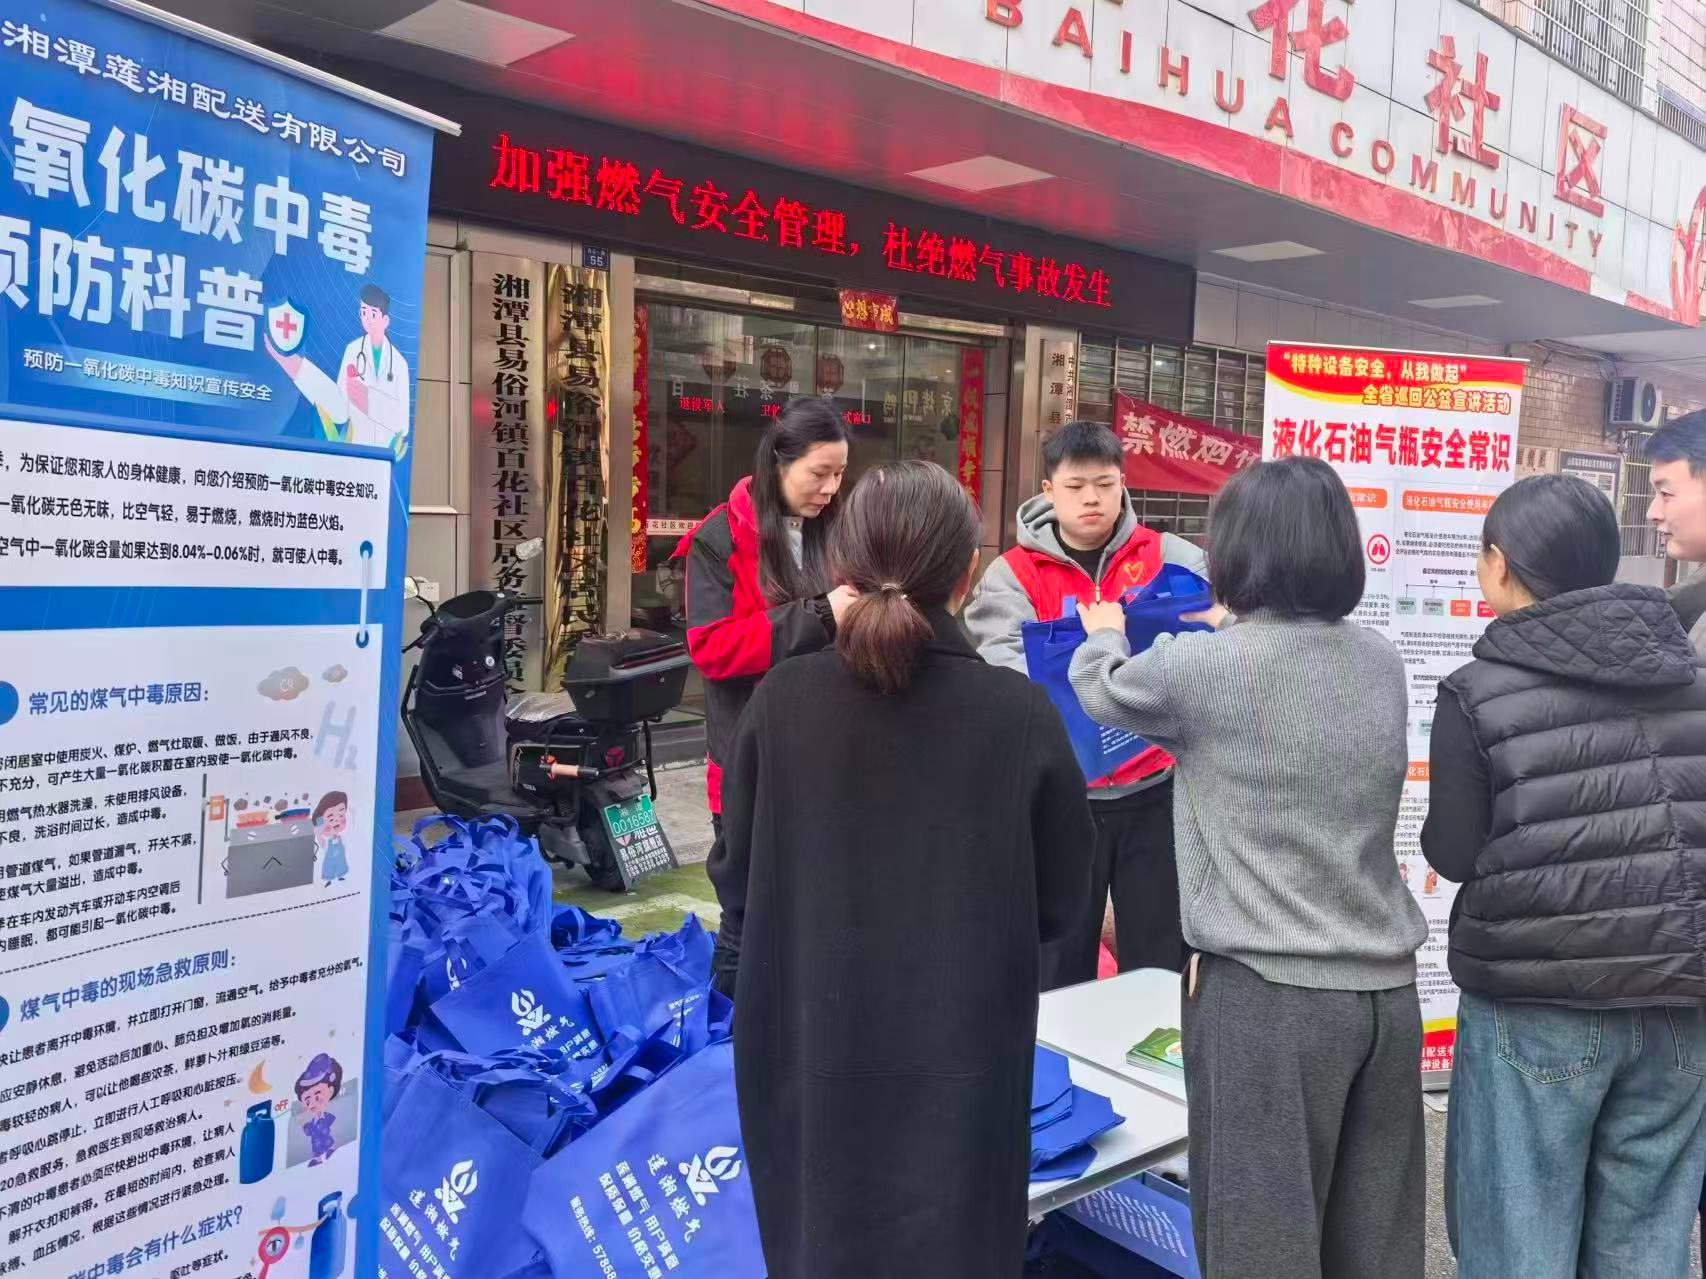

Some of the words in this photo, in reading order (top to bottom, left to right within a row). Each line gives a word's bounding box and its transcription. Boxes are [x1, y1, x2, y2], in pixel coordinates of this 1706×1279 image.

[1, 20, 407, 177] 湘潭莲湘配送有限公司
[984, 0, 1293, 138] BAIHUA
[1329, 121, 1605, 258] COMMUNITY
[9, 97, 373, 275] 氧化碳中毒
[489, 130, 1112, 308] 加强燃气安全管理，杜绝燃气事故发生
[589, 256, 604, 267] 55
[23, 348, 273, 401] 预防一氧化碳中毒知识宣传安全
[1362, 384, 1511, 415] 全省巡回公益宣讲活动
[1273, 417, 1511, 472] 液化石油气瓶安全常识
[1407, 766, 1429, 777] 化石
[20, 949, 236, 1022] 煤气中毒的现场急救原则：
[520, 1015, 575, 1052] 湘燃气
